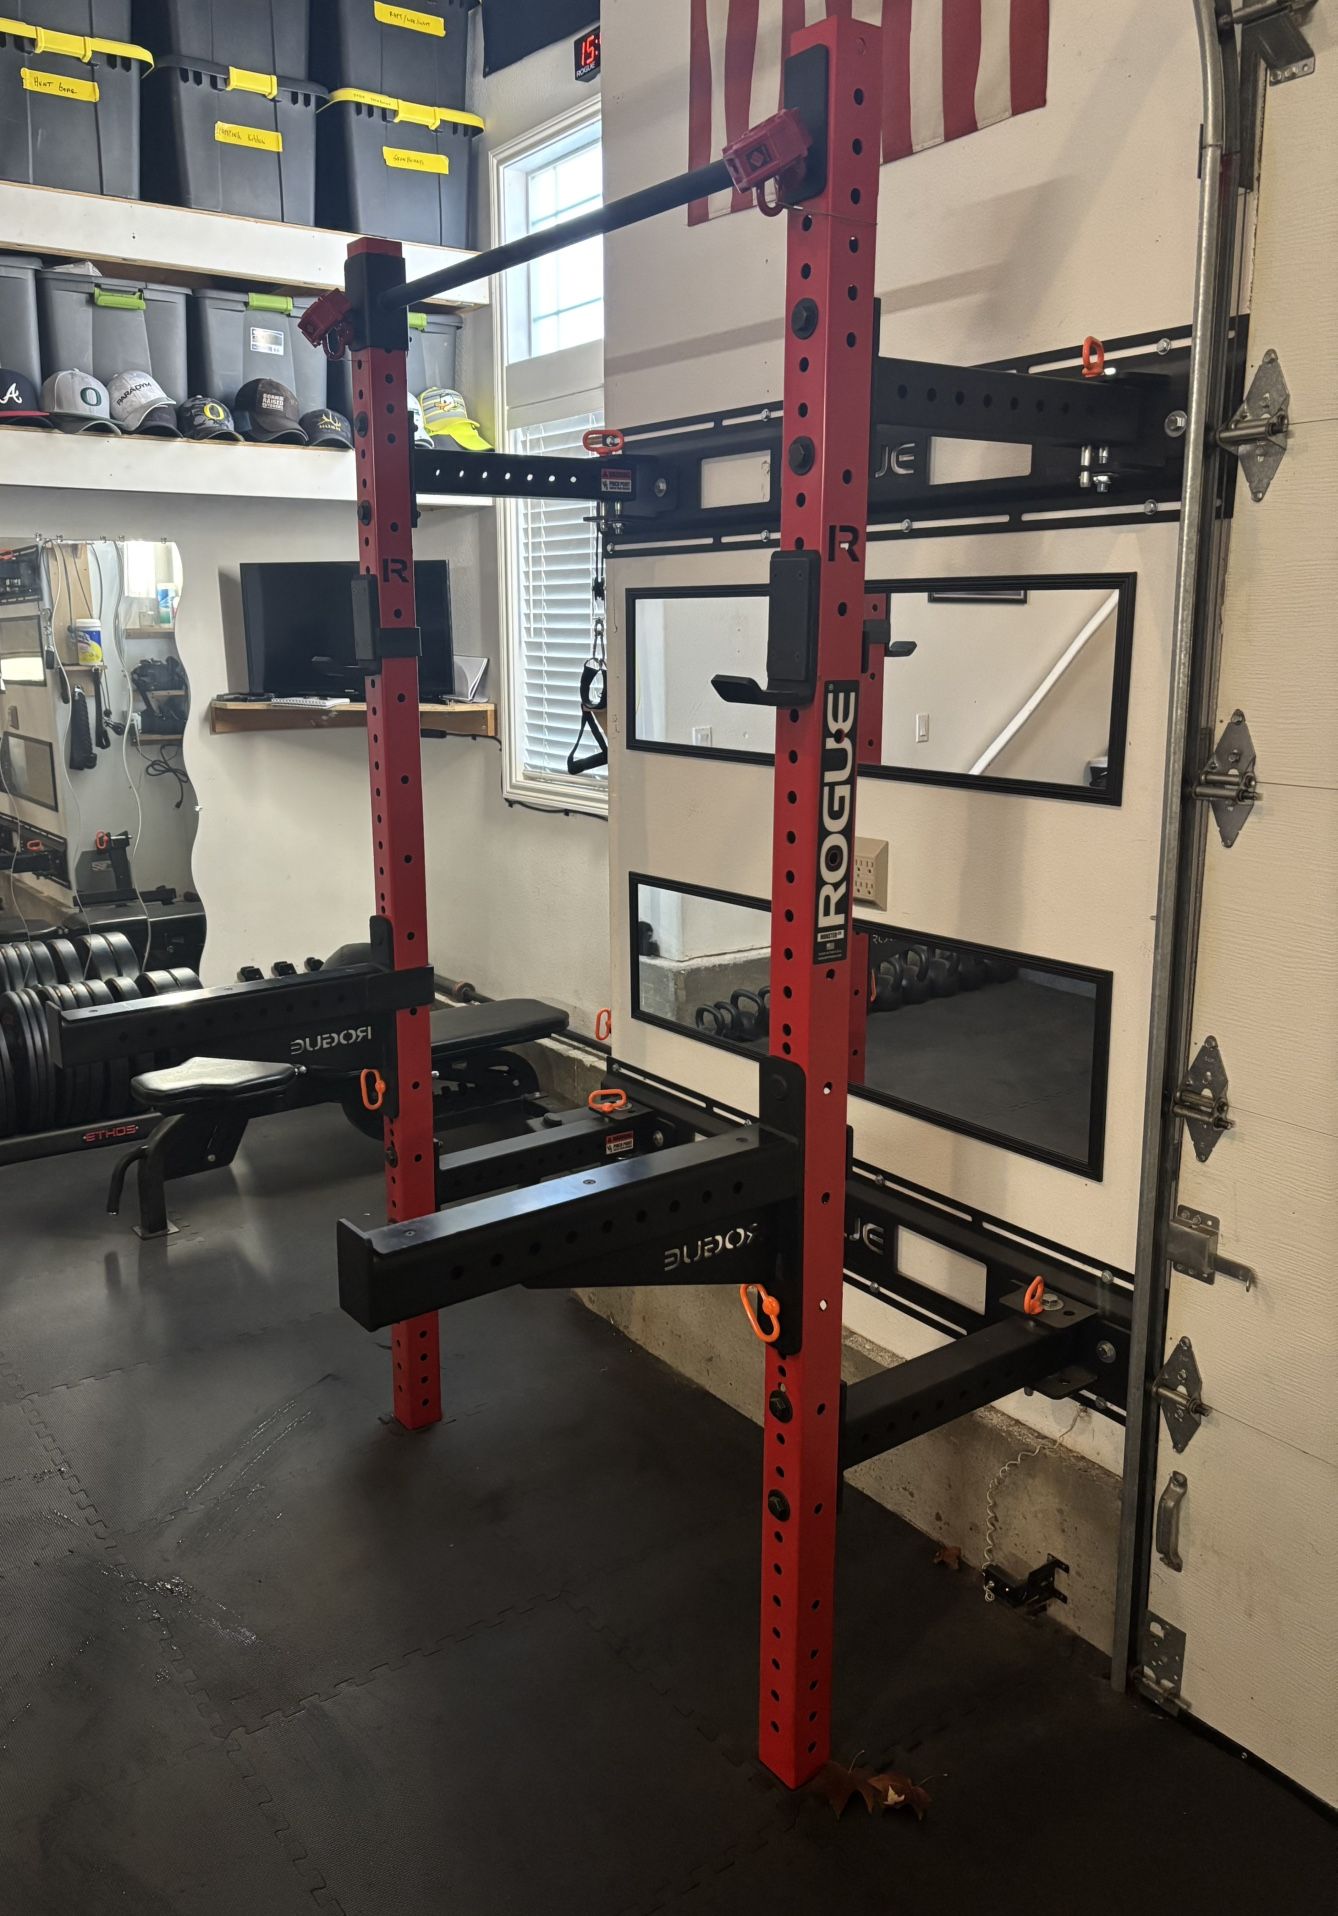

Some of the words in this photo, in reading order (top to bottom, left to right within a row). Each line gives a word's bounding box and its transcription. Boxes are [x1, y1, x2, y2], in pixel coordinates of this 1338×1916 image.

[80, 386, 102, 407] O
[116, 381, 152, 406] PARADYM
[203, 402, 225, 421] O
[818, 691, 856, 929] ROGUE
[85, 1124, 138, 1142] ETHOS
